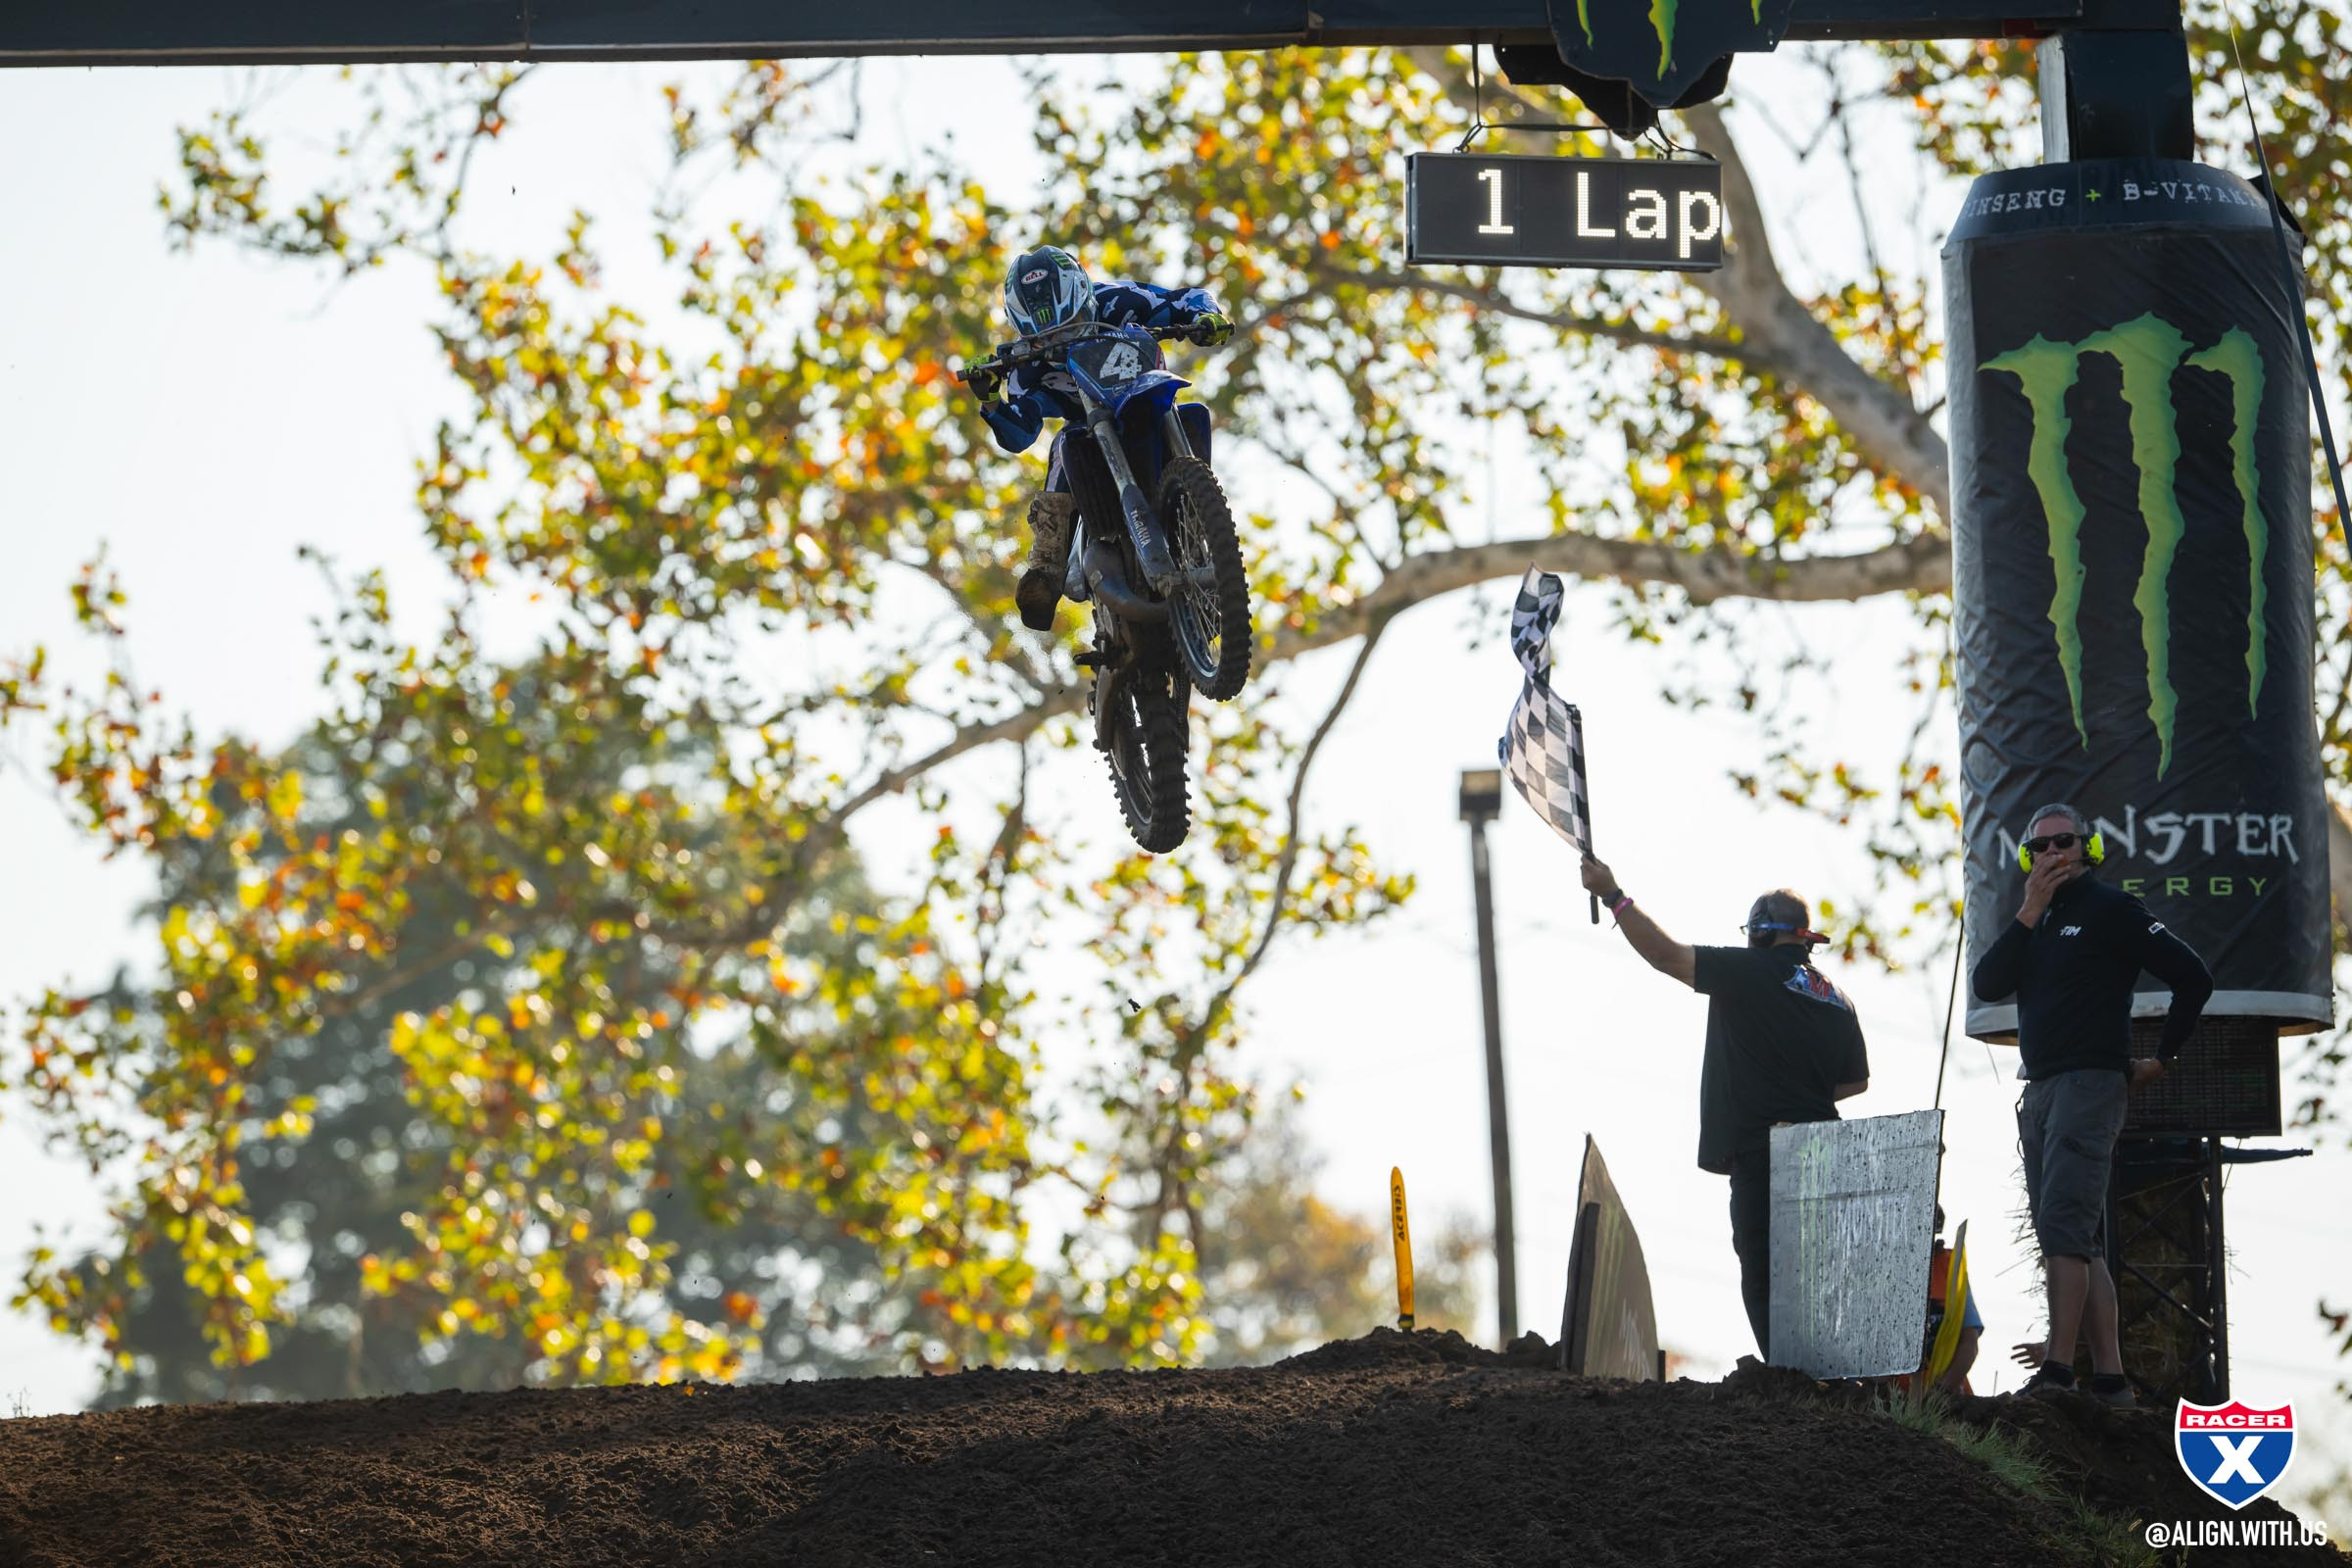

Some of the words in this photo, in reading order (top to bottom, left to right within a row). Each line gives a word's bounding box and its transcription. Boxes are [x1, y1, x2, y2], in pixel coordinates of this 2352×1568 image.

[1479, 169, 1513, 234] 1
[1577, 172, 1720, 258] Lap
[1024, 271, 1043, 282] BELL
[1100, 341, 1143, 380] 4
